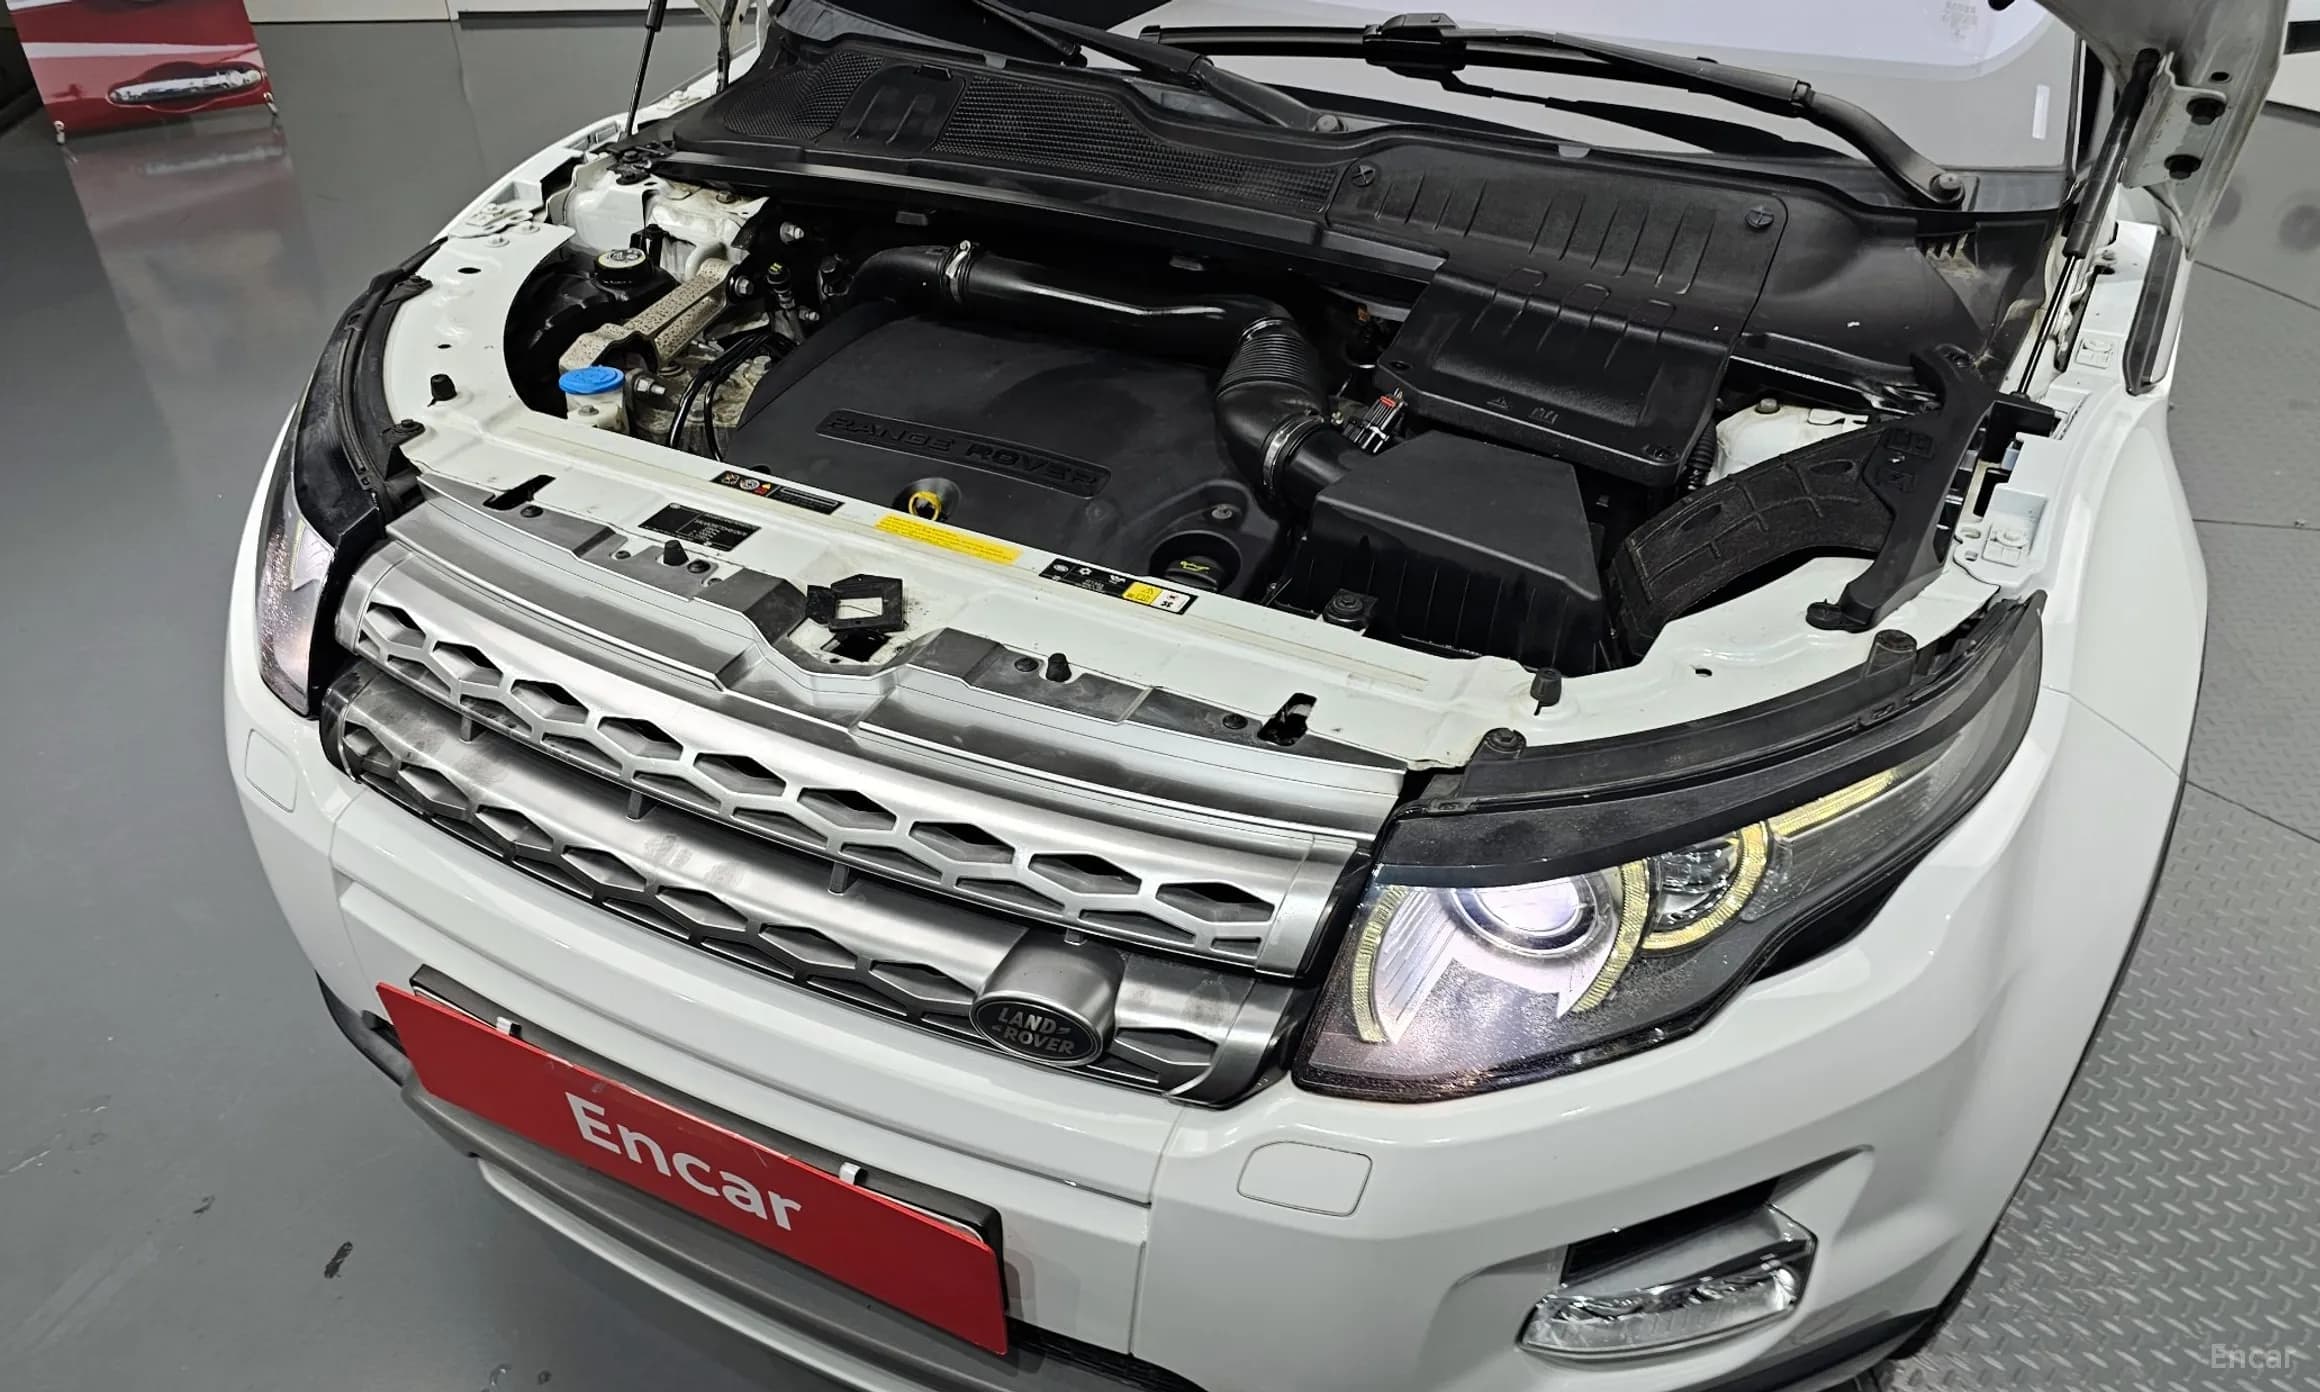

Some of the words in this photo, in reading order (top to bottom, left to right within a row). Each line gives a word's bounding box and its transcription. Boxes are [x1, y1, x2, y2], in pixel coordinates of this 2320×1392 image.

[826, 414, 955, 451] RANGE
[964, 441, 1099, 486] ROVER
[997, 1007, 1057, 1034] LAND
[1003, 1024, 1075, 1055] ROVER
[565, 1091, 802, 1231] Encar
